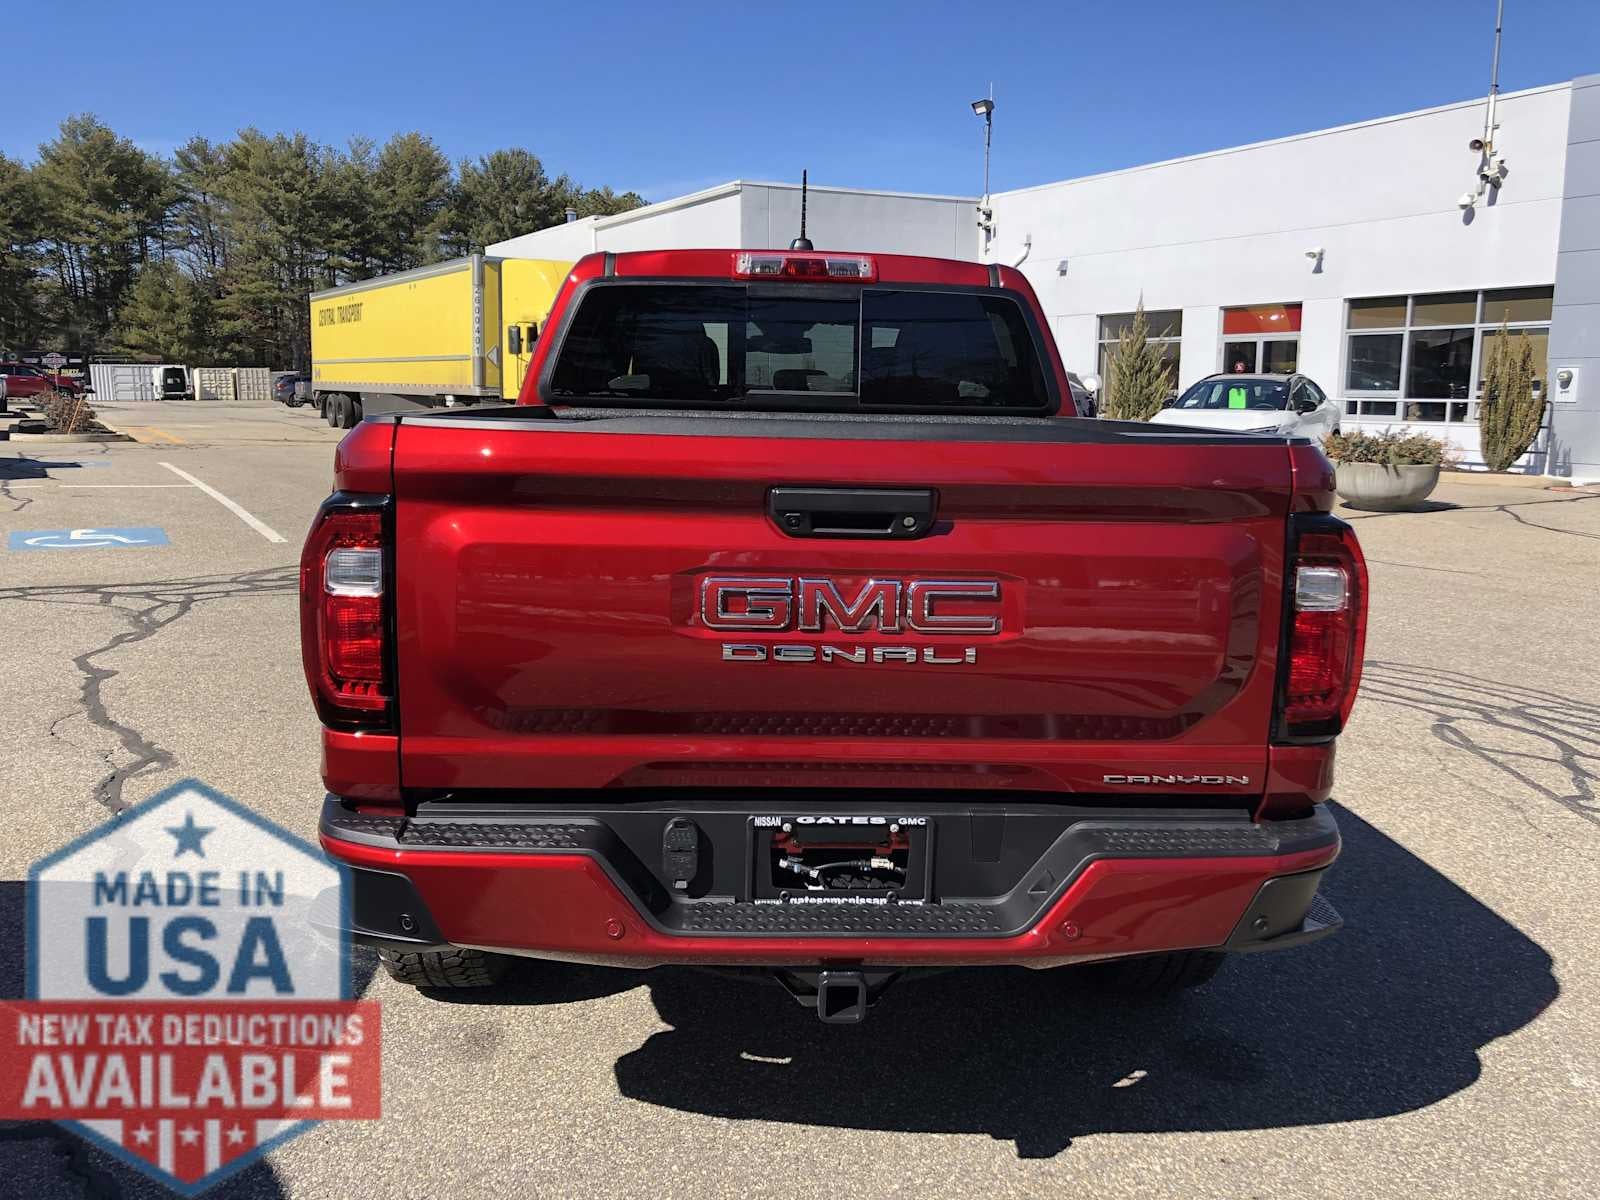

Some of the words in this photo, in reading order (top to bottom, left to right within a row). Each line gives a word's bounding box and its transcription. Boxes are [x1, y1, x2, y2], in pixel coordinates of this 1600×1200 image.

[319, 308, 336, 327] CENTRAL
[337, 302, 364, 324] TRANSPORT
[701, 576, 1002, 634] GMC
[721, 643, 978, 664] DENALI
[1103, 774, 1249, 785] CANYON
[754, 816, 782, 827] NISSAN
[796, 816, 887, 825] GATES
[898, 817, 926, 826] GMC
